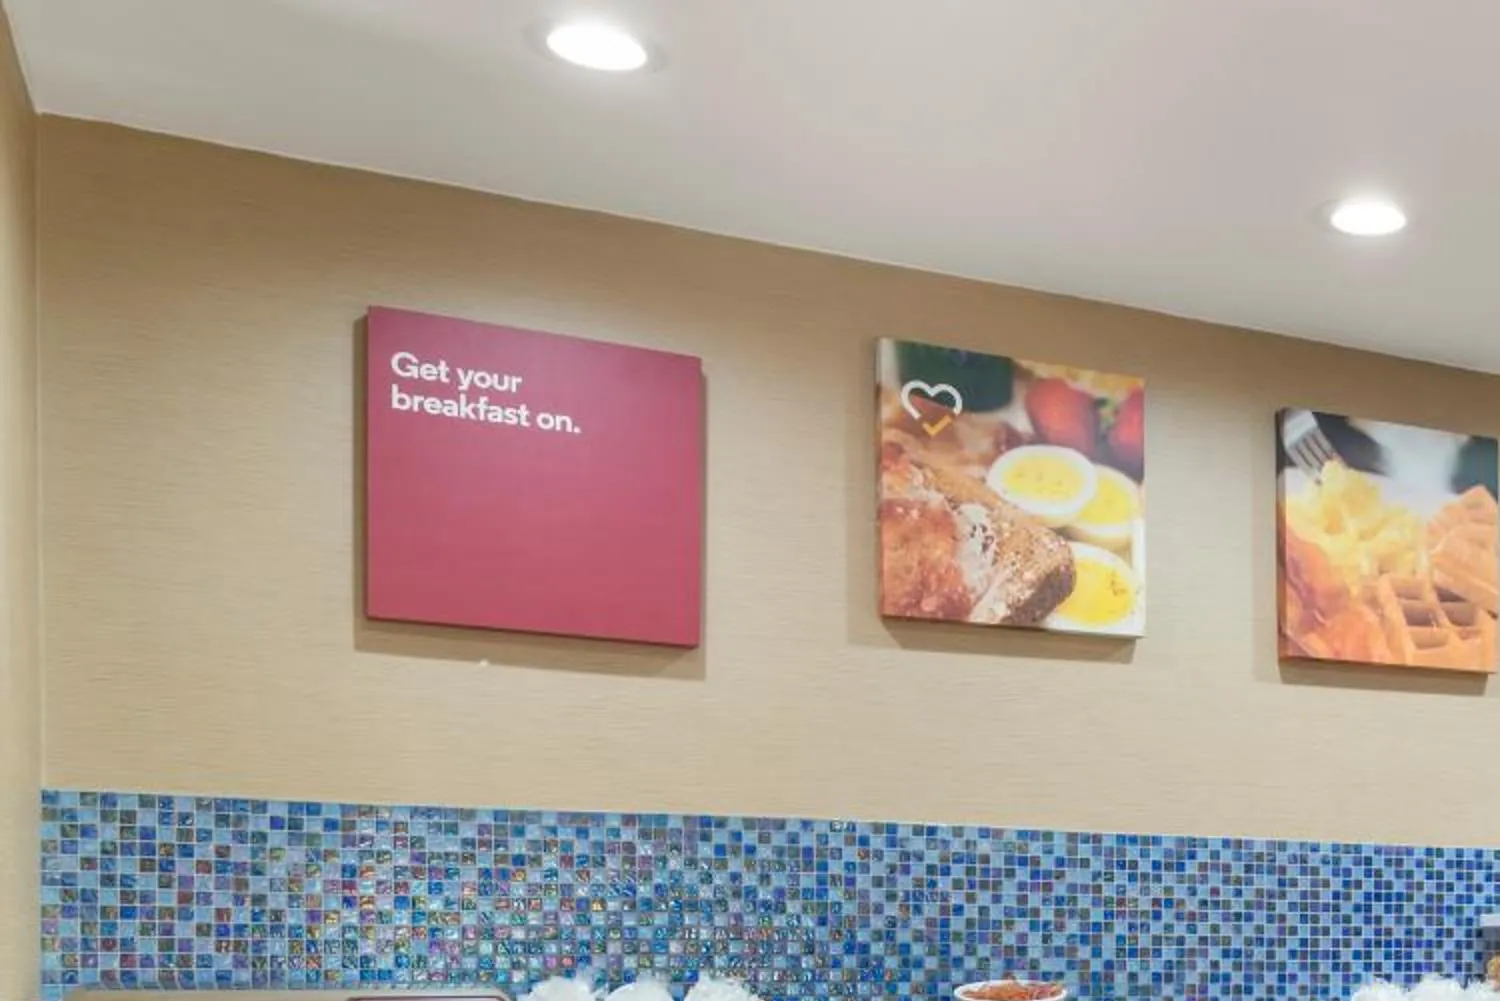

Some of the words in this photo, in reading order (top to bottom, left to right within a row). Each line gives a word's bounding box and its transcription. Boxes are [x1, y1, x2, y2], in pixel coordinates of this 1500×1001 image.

[390, 351, 450, 383] Get
[456, 366, 523, 393] your
[390, 384, 531, 428] breakfast
[536, 411, 582, 434] on.
